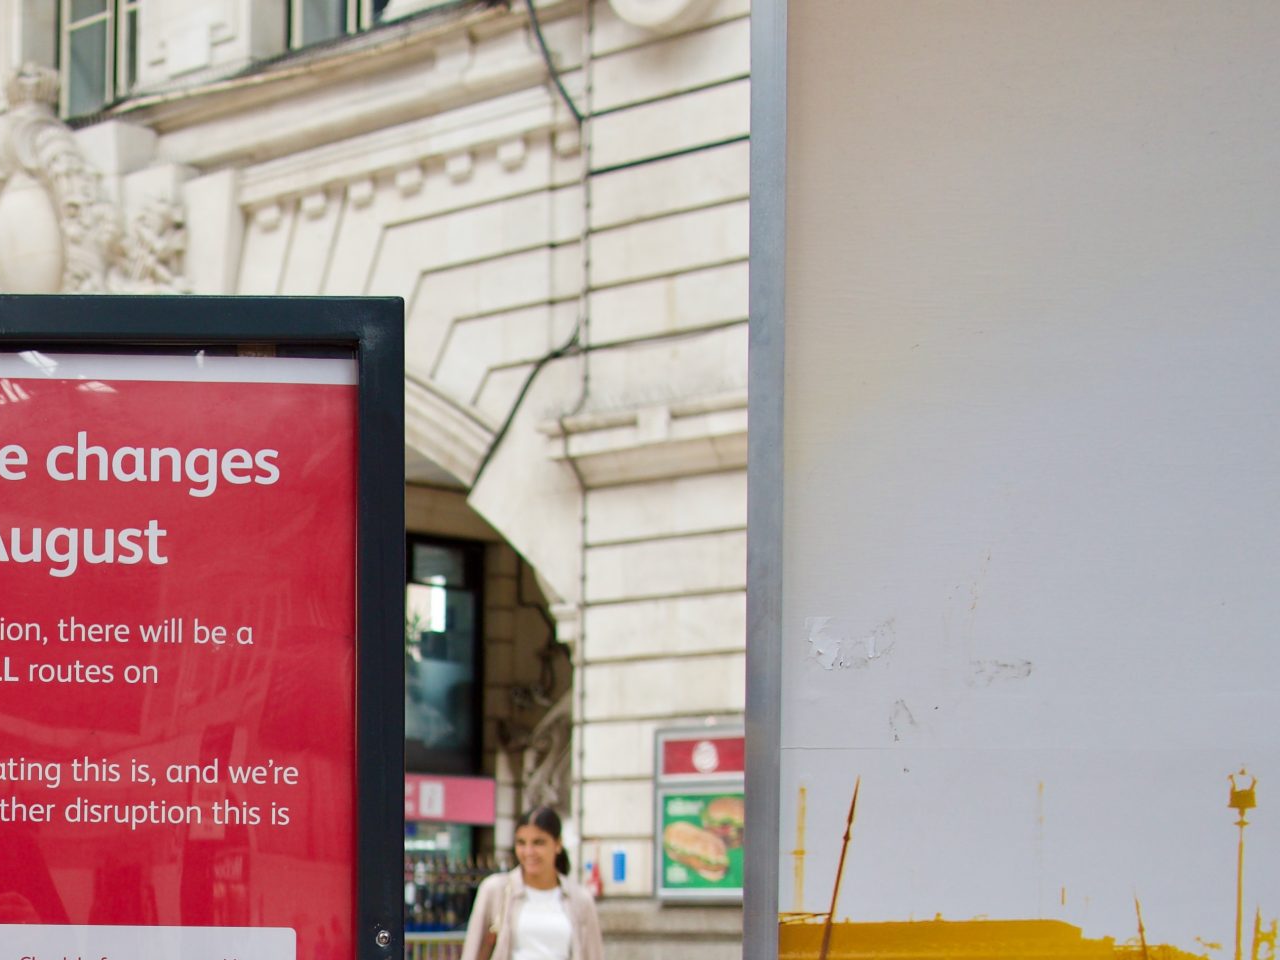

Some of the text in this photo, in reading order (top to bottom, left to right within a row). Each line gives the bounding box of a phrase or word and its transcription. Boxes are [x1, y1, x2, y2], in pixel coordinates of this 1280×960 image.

[47, 431, 279, 497] changes
[58, 617, 129, 642] there
[140, 618, 182, 643] will
[194, 618, 226, 644] be
[237, 627, 253, 644] a
[30, 661, 113, 683] routes
[124, 666, 157, 683] on
[72, 757, 120, 782] this
[132, 759, 156, 786] is,
[167, 758, 218, 783] and
[229, 760, 298, 784] we're
[65, 797, 201, 830] disruption
[212, 800, 260, 824] this
[272, 802, 289, 825] is
